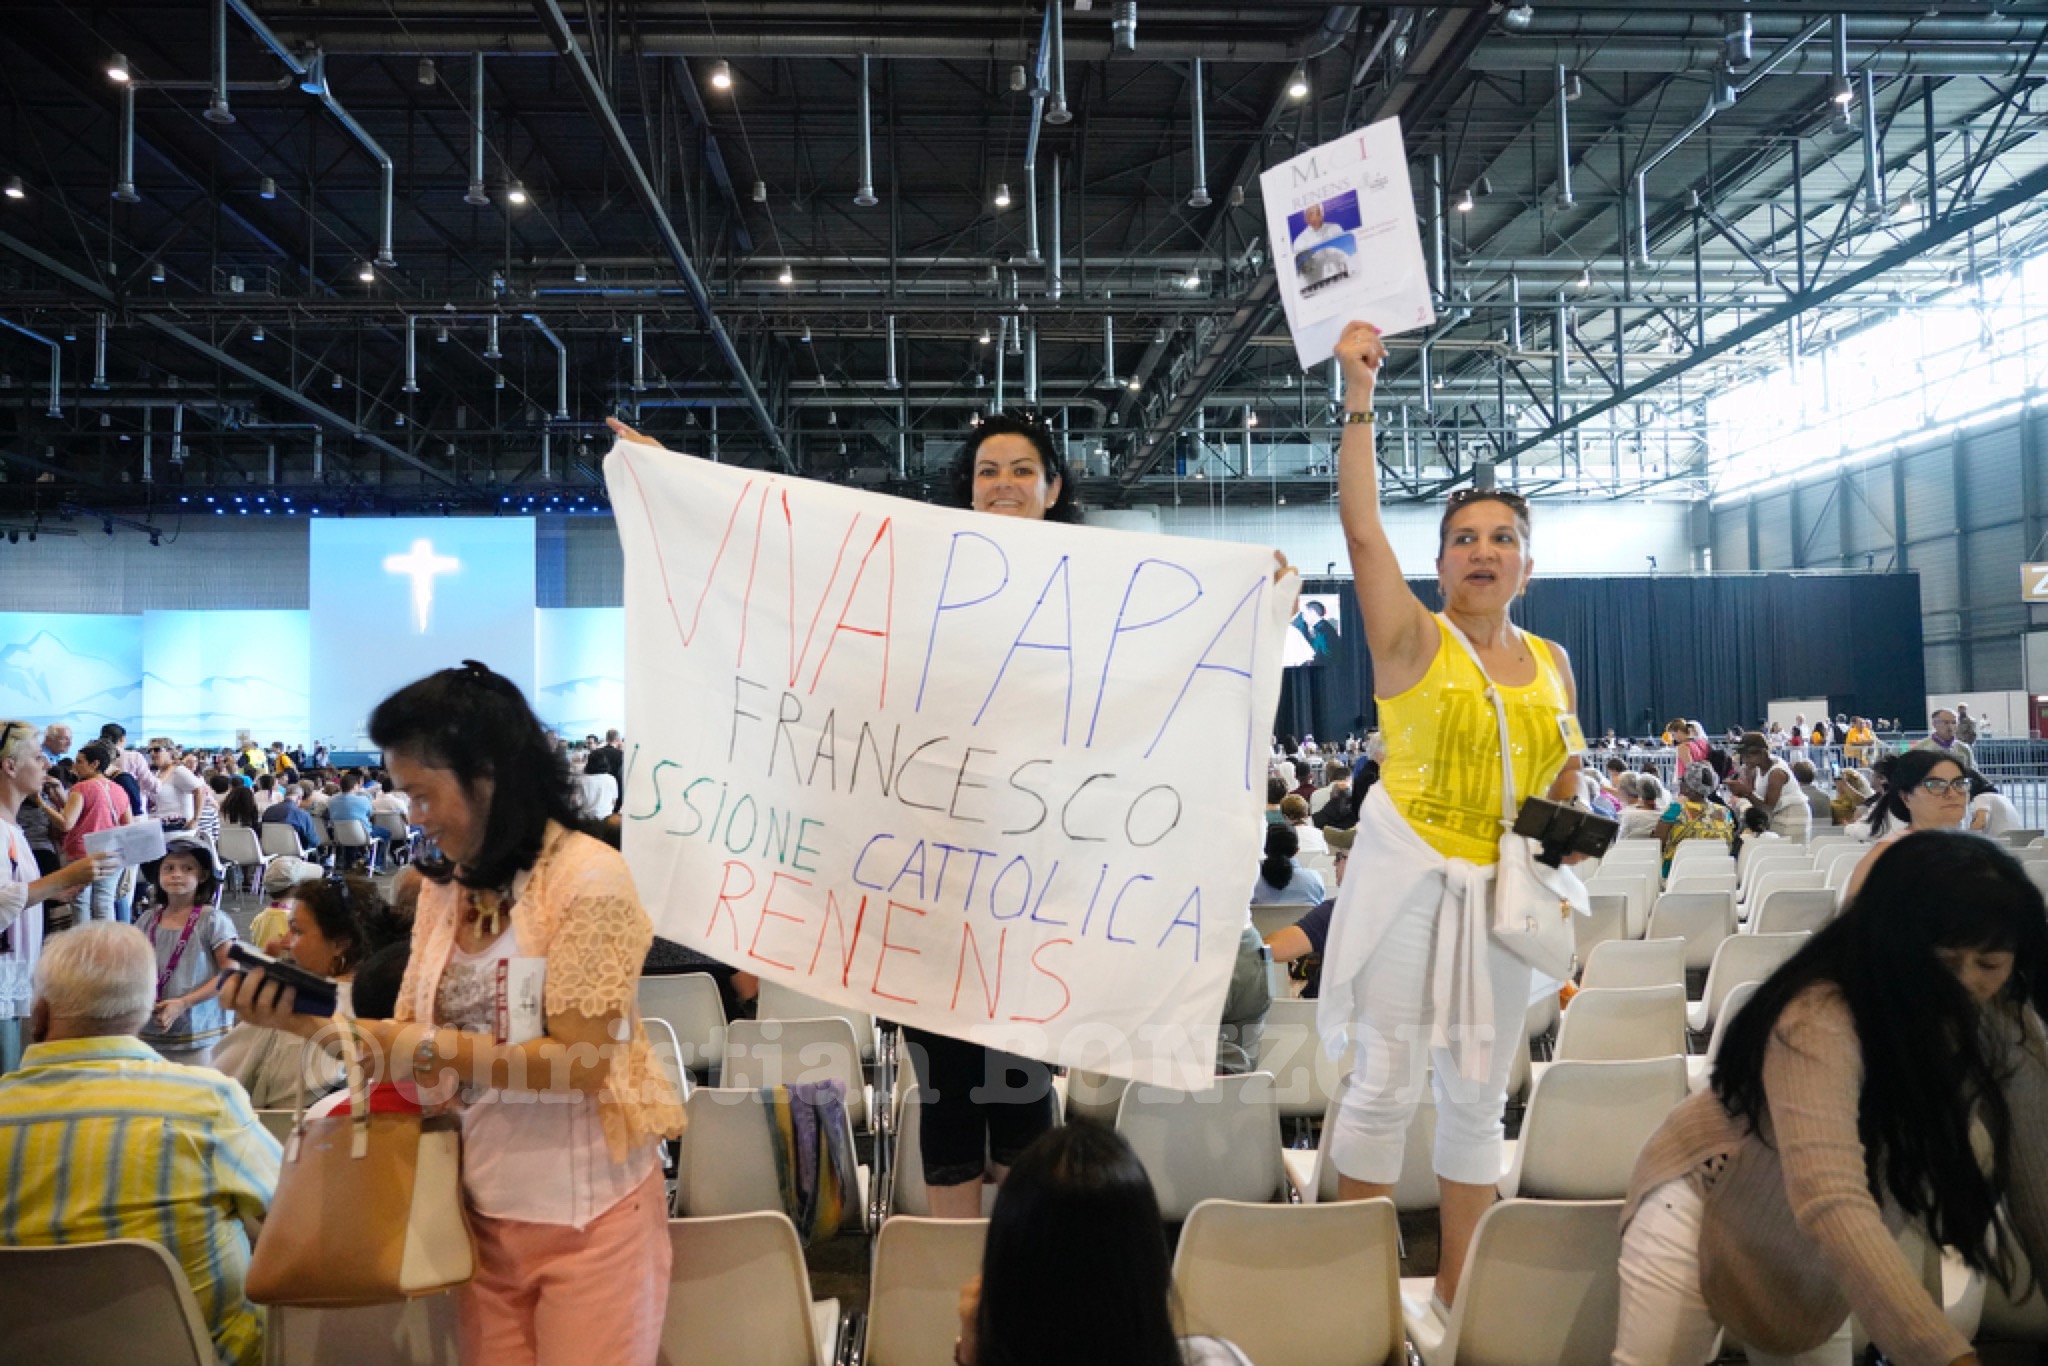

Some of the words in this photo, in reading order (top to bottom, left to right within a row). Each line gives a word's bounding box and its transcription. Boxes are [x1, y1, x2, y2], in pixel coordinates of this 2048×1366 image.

[621, 450, 895, 711] VIVA
[915, 531, 1267, 791] PAPA
[728, 675, 1182, 847] FRANCESCO
[705, 861, 1074, 1024] RENENS
[852, 833, 1201, 963] CATTOLICA
